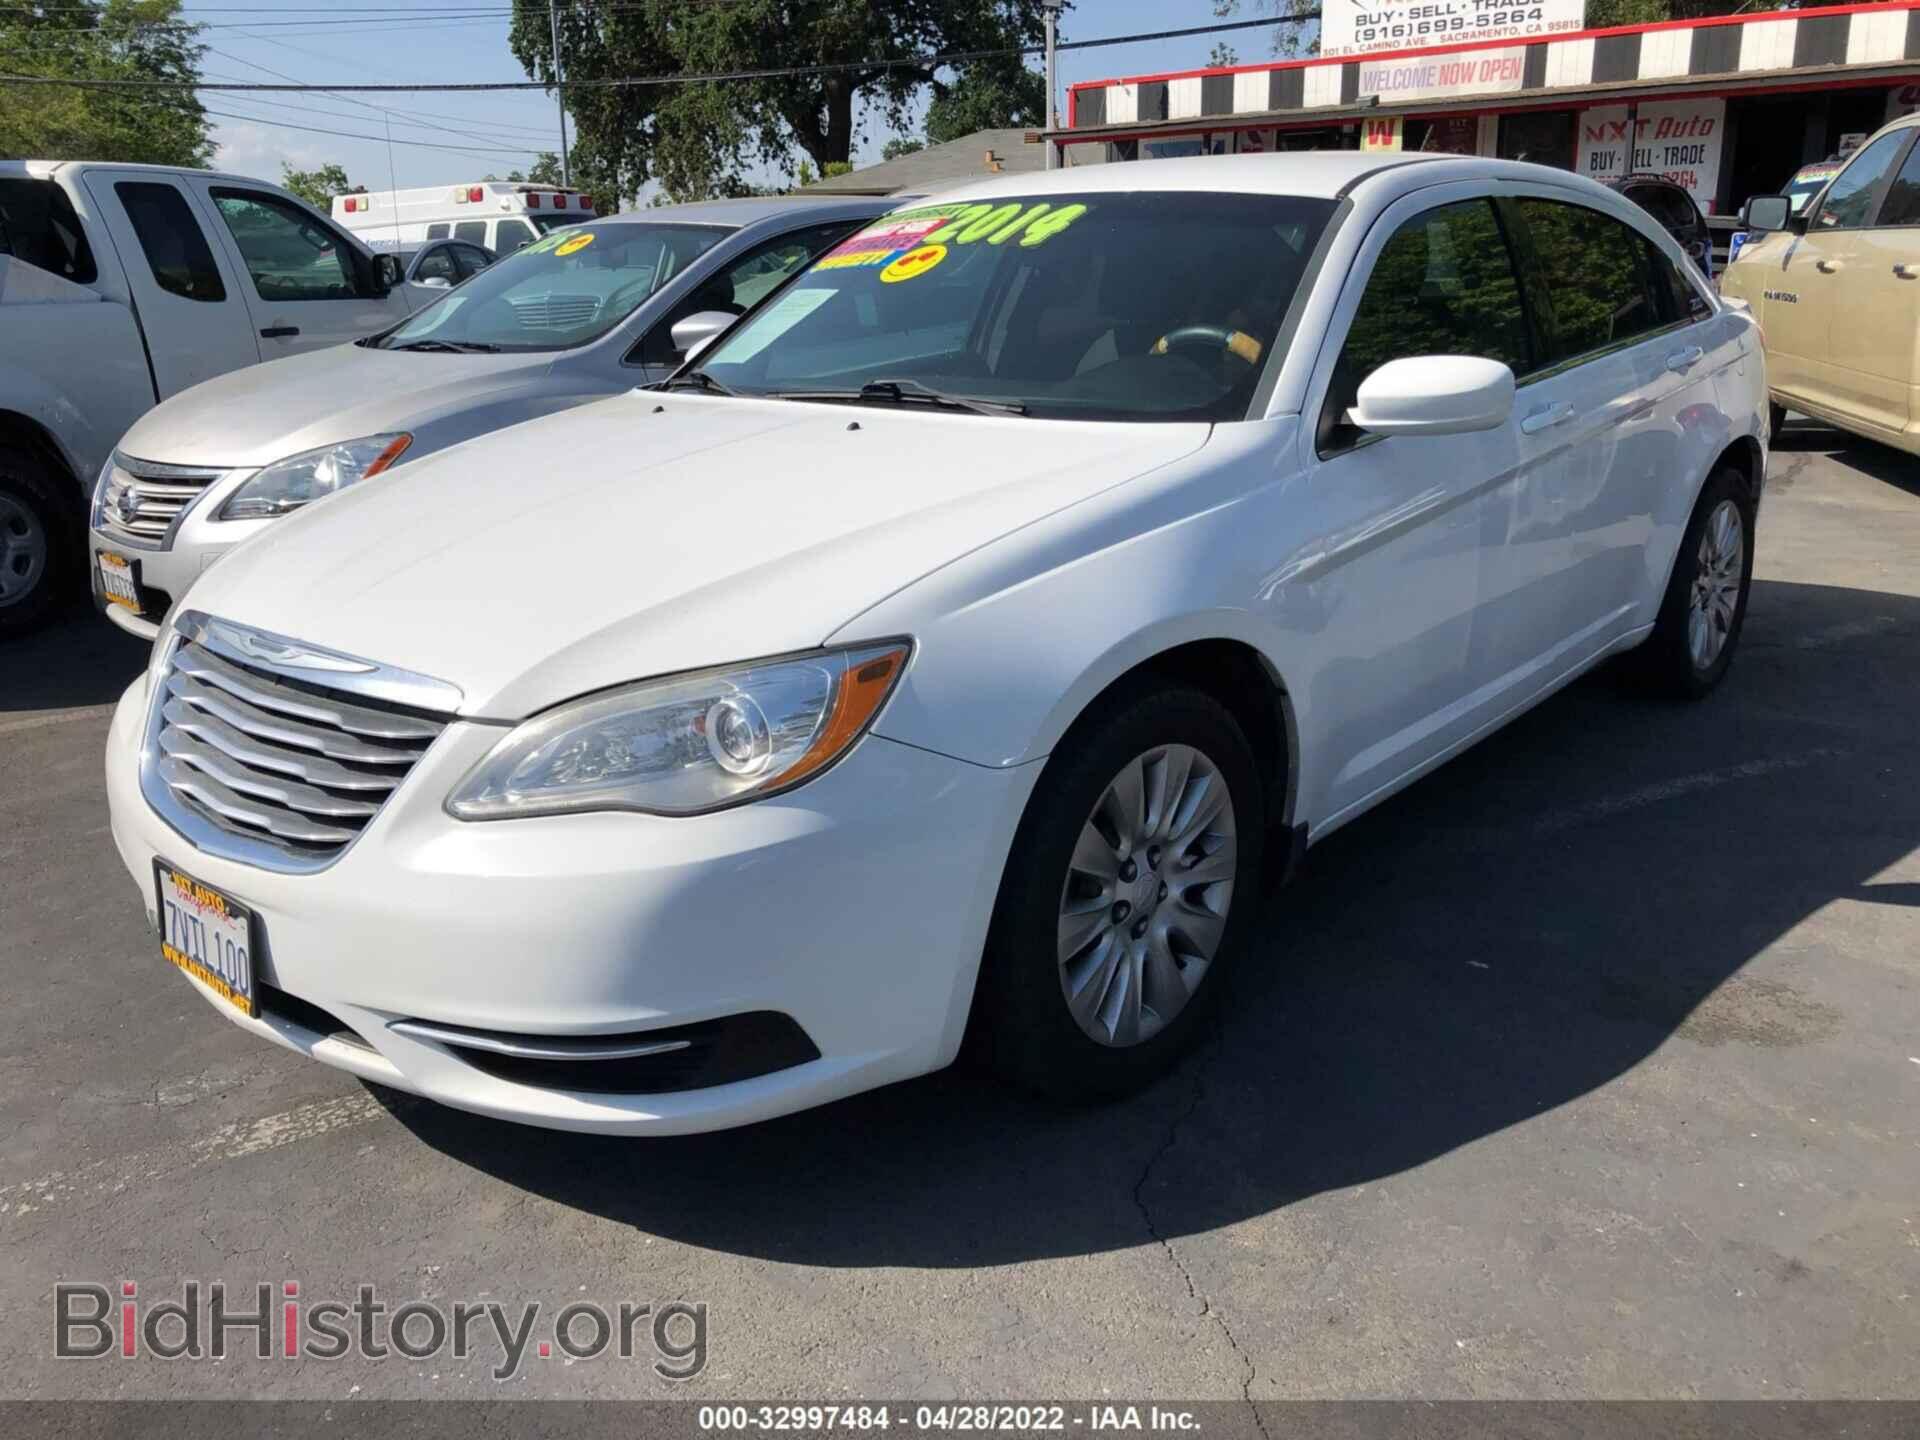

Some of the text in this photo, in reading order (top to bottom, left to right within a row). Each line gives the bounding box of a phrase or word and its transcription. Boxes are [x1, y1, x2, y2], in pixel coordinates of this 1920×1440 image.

[1355, 10, 1395, 27] BUY
[1409, 4, 1457, 20] SELL
[1355, 8, 1543, 42] (916)699-5264
[1360, 40, 1400, 52] CAMINO
[1526, 24, 1542, 34] CA
[1548, 20, 1581, 32] 95815
[1364, 56, 1522, 91] WELCOME NOW OPEN
[1585, 110, 1716, 143] NXT Auto
[1590, 151, 1616, 171] BUY
[1664, 144, 1706, 166] TRADE
[922, 203, 1087, 247] 2014
[195, 885, 225, 913] AUTO
